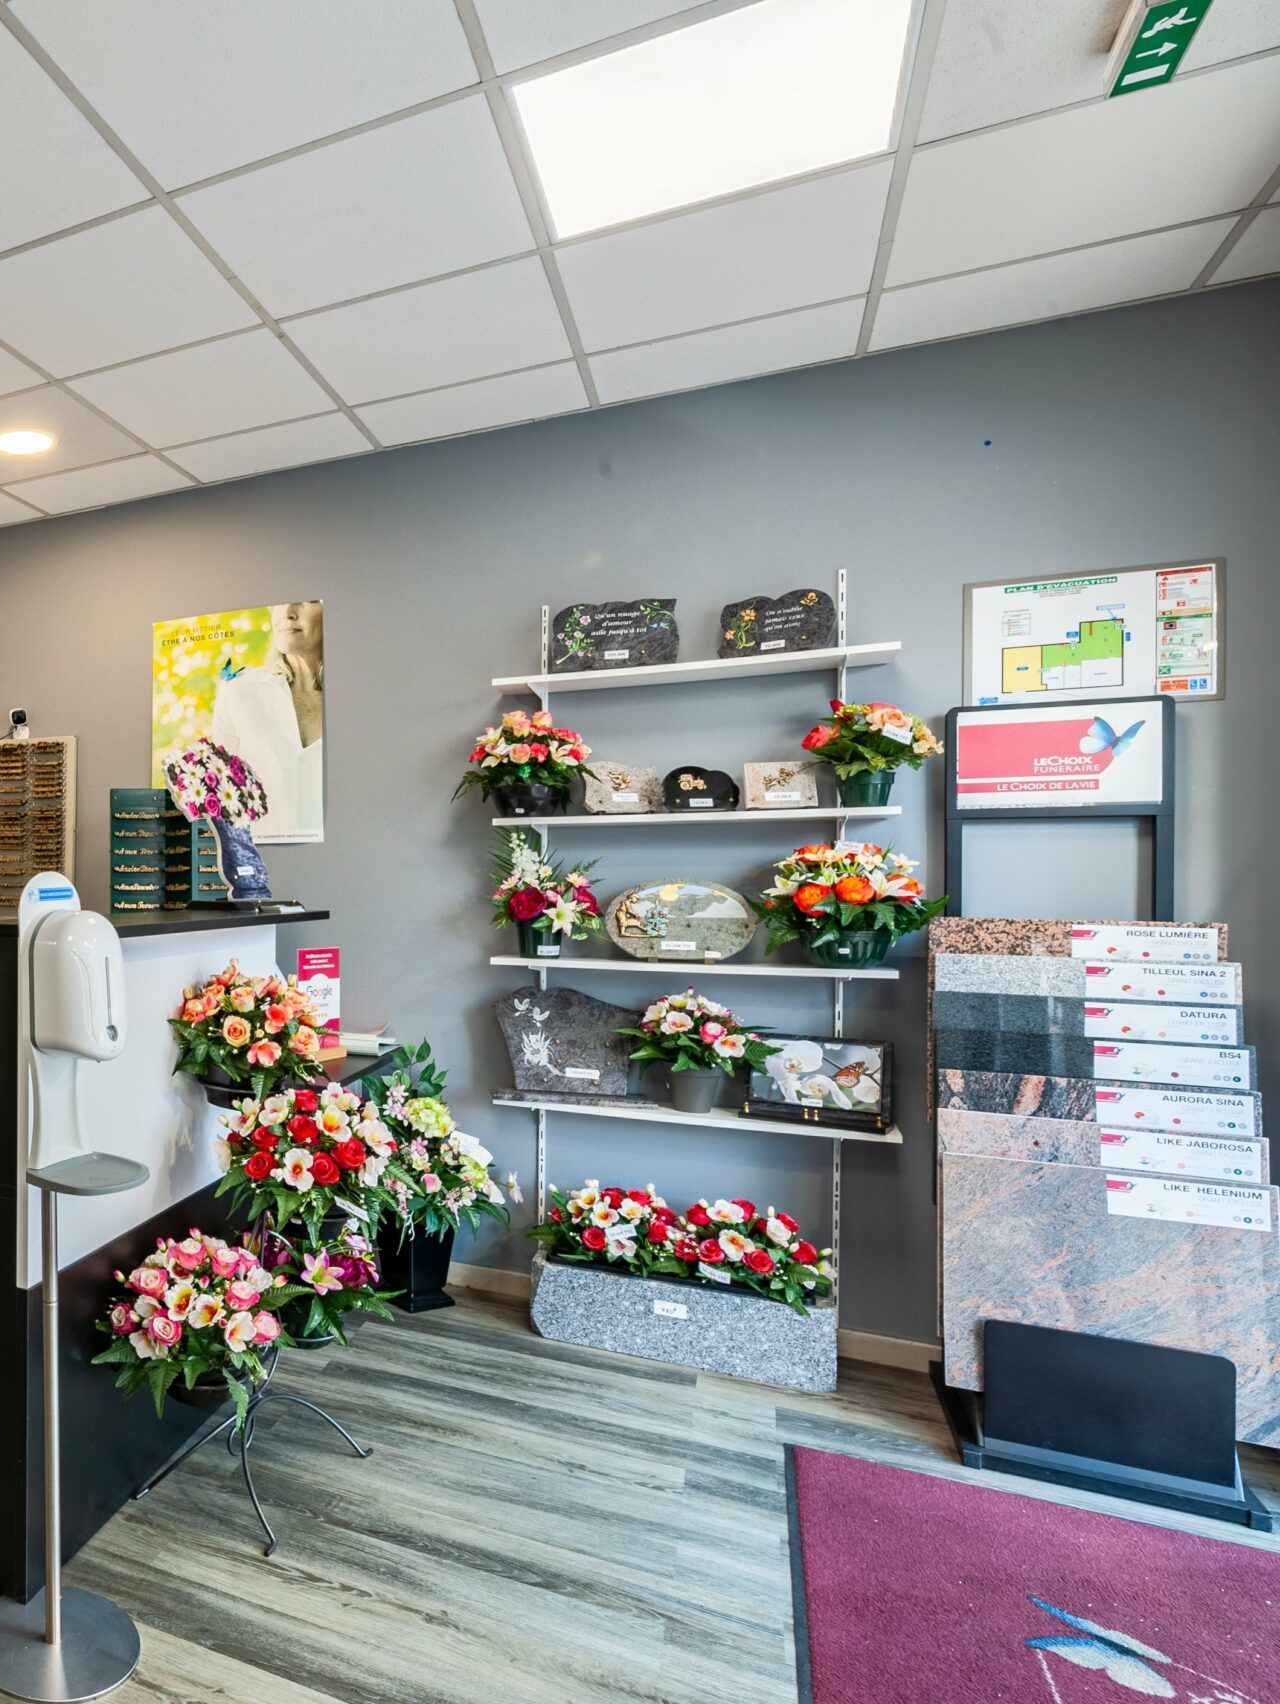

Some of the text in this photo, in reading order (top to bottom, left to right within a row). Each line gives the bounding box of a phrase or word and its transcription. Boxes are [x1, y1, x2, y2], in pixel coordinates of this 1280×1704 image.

[996, 783, 1009, 792] LE
[1010, 782, 1047, 791] CHOIX
[1049, 782, 1064, 790] DE
[1080, 781, 1096, 789] VIE
[1126, 930, 1156, 938] ROSE
[1141, 967, 1187, 976] TILLEUL
[1189, 969, 1217, 978] SINA
[1179, 1011, 1228, 1020] DATURA
[1219, 1051, 1242, 1060] BS4
[1161, 1095, 1245, 1107] AURORA SINA
[1156, 1137, 1254, 1153] LIKE JABOROSA
[1163, 1183, 1263, 1200] LIKE HELENIUM
